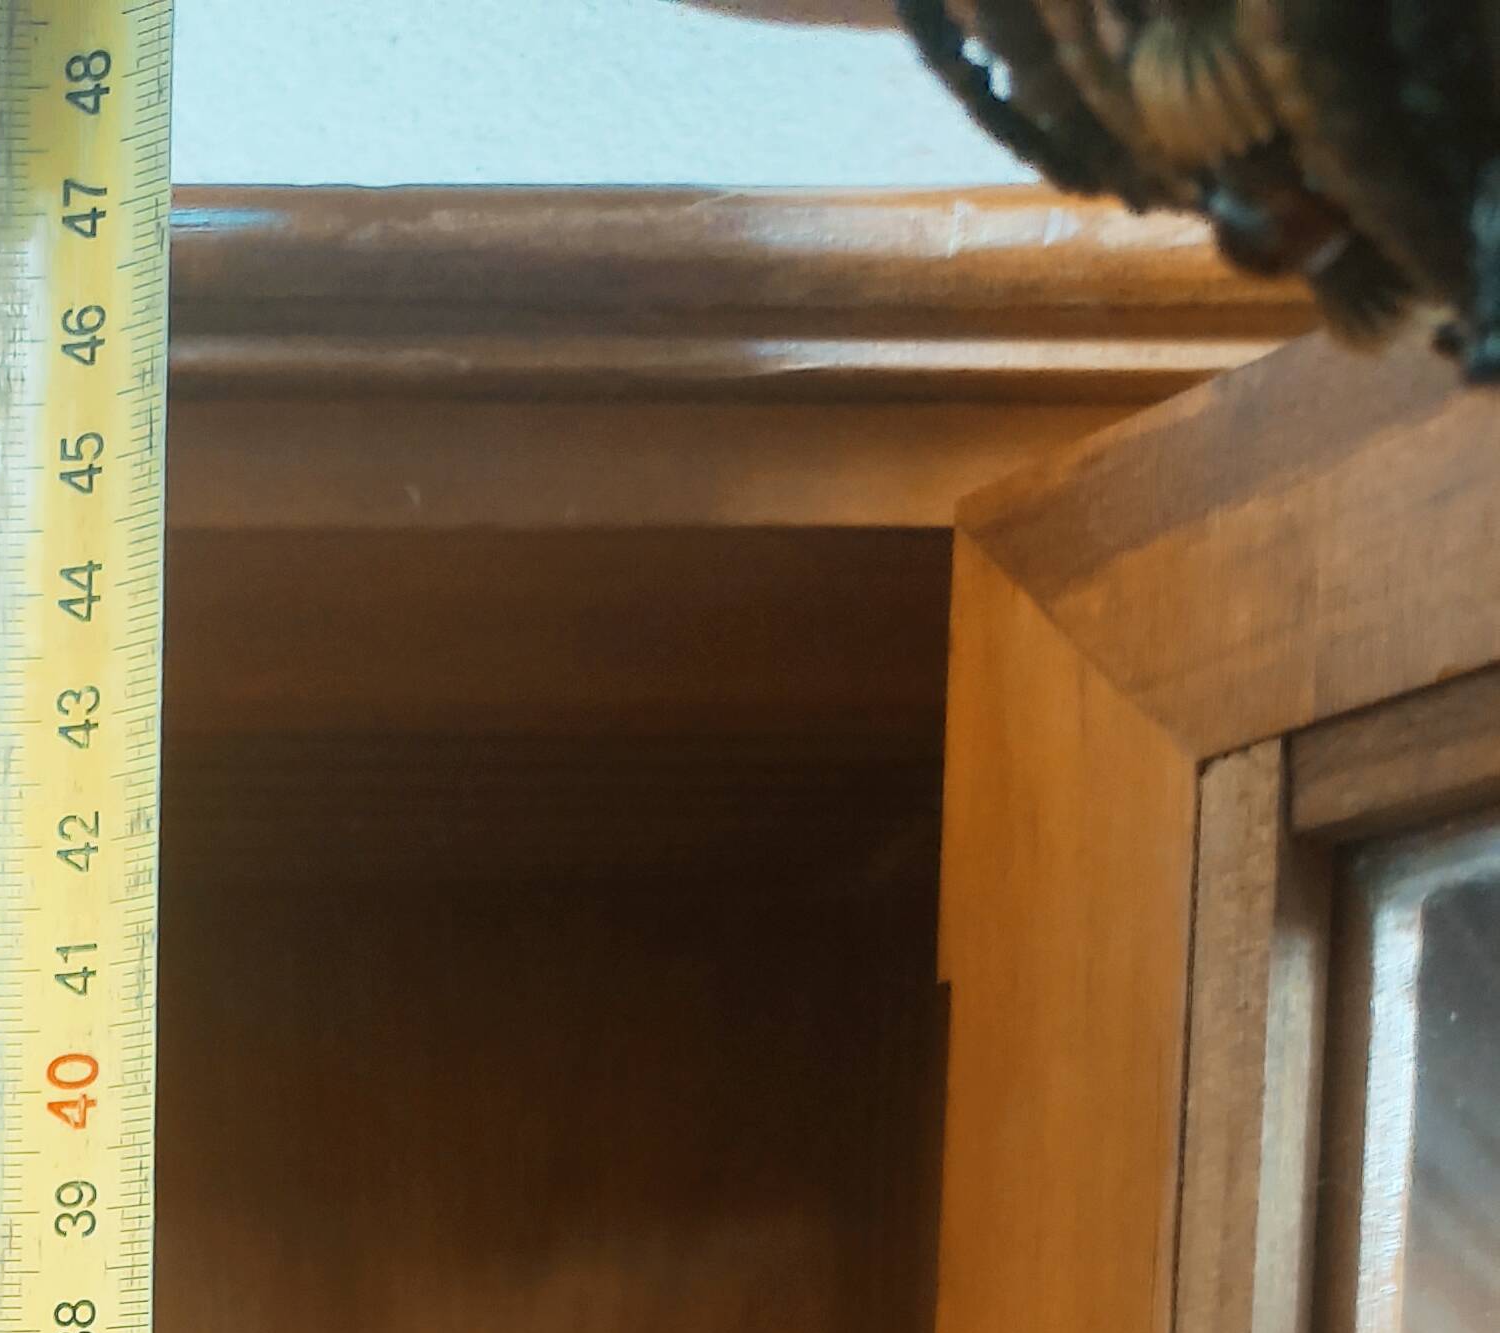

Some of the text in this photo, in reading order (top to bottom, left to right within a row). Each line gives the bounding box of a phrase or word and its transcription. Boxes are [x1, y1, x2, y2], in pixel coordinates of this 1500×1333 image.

[64, 49, 112, 116] 48
[61, 178, 108, 239] 47
[60, 304, 107, 366] 46
[58, 431, 105, 494] 45
[57, 559, 103, 622] 44
[56, 685, 101, 749] 43
[55, 810, 100, 873] 42
[53, 942, 98, 996] 41
[46, 1052, 100, 1130] 40
[53, 1180, 98, 1238] 39
